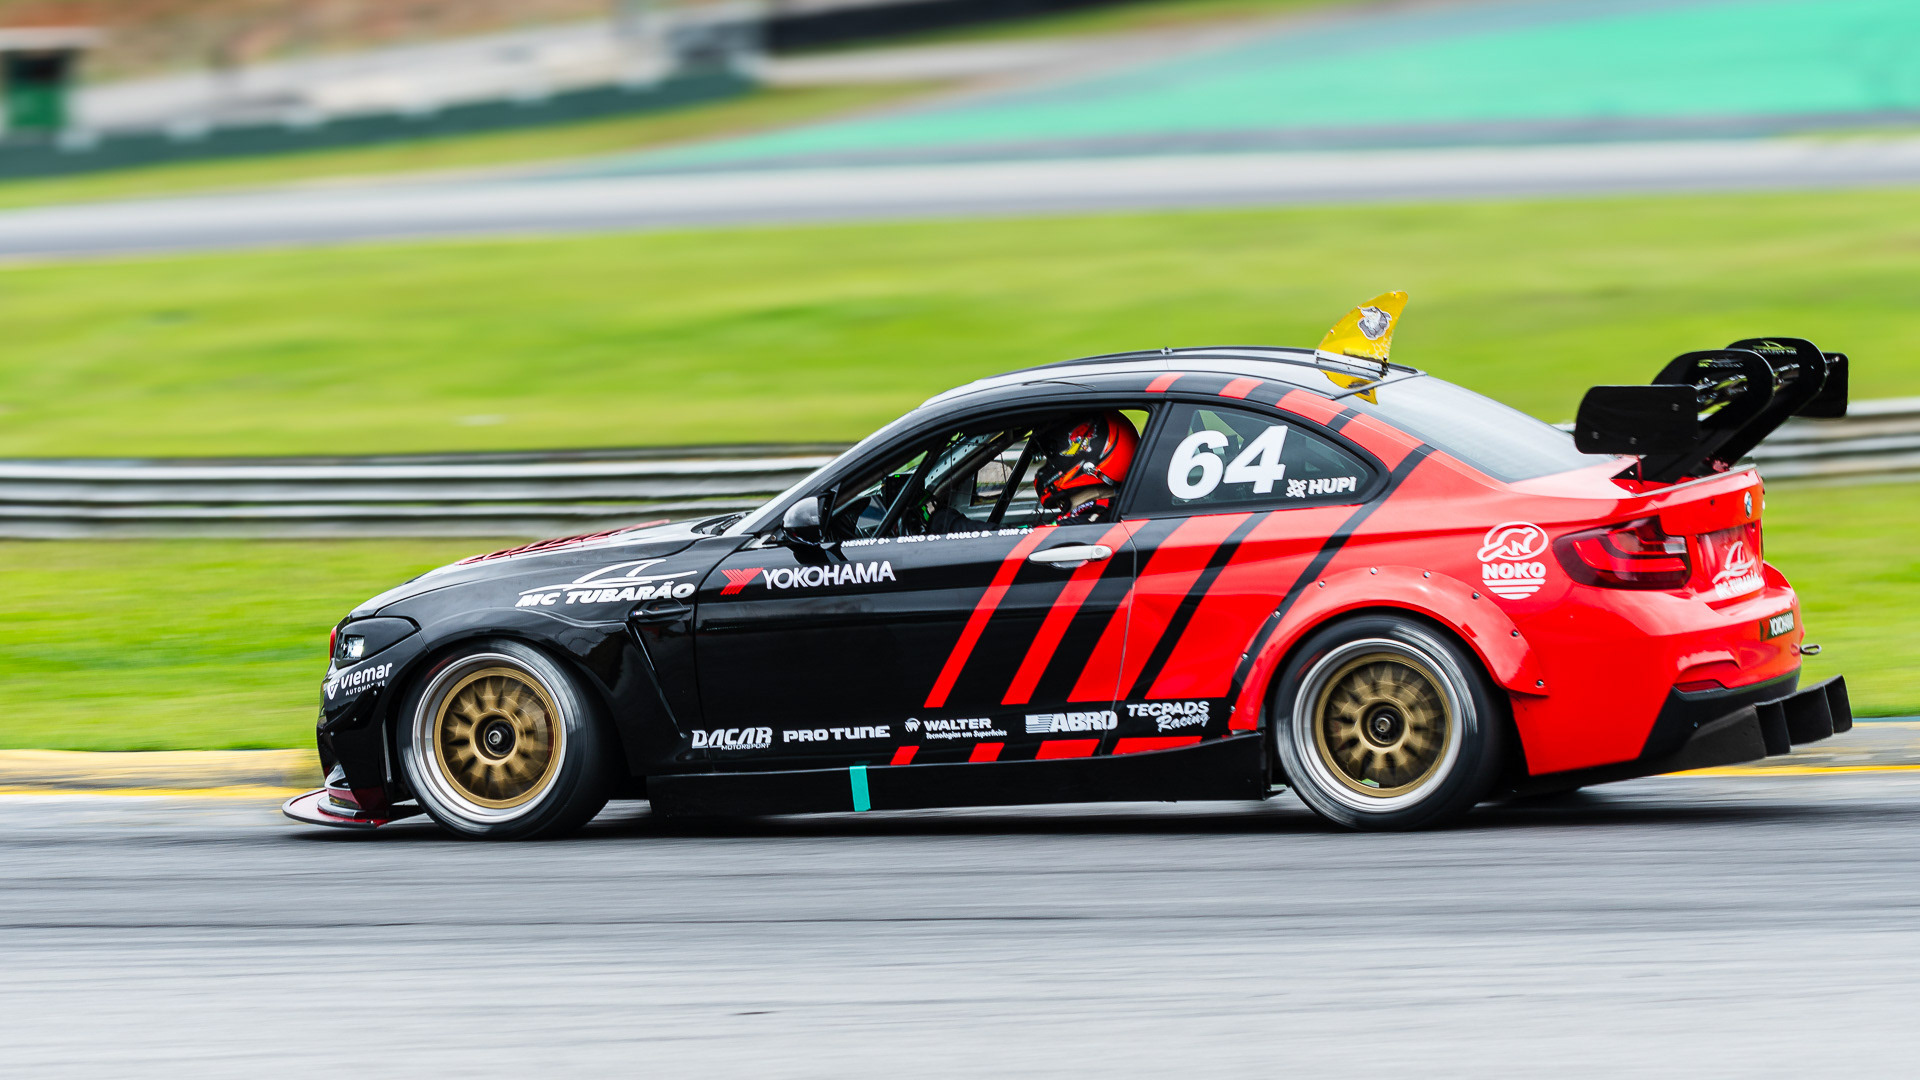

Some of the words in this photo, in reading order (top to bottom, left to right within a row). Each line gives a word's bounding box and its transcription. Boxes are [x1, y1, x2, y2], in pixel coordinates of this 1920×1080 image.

[1167, 425, 1288, 499] 64
[1308, 476, 1357, 495] HUPI
[896, 534, 926, 544] ENZO
[946, 530, 980, 540] PAULO
[763, 561, 896, 589] YOKOHAMA
[1482, 562, 1546, 579] NOKO
[514, 592, 562, 608] MC
[566, 581, 696, 604] TUBARÃO
[1126, 701, 1210, 718] TECPADS
[923, 717, 992, 732] WALTER
[1049, 710, 1119, 733] ABRO
[1155, 712, 1211, 733] Racing
[692, 727, 772, 748] DACAR
[721, 742, 771, 751] MOTORSPORT
